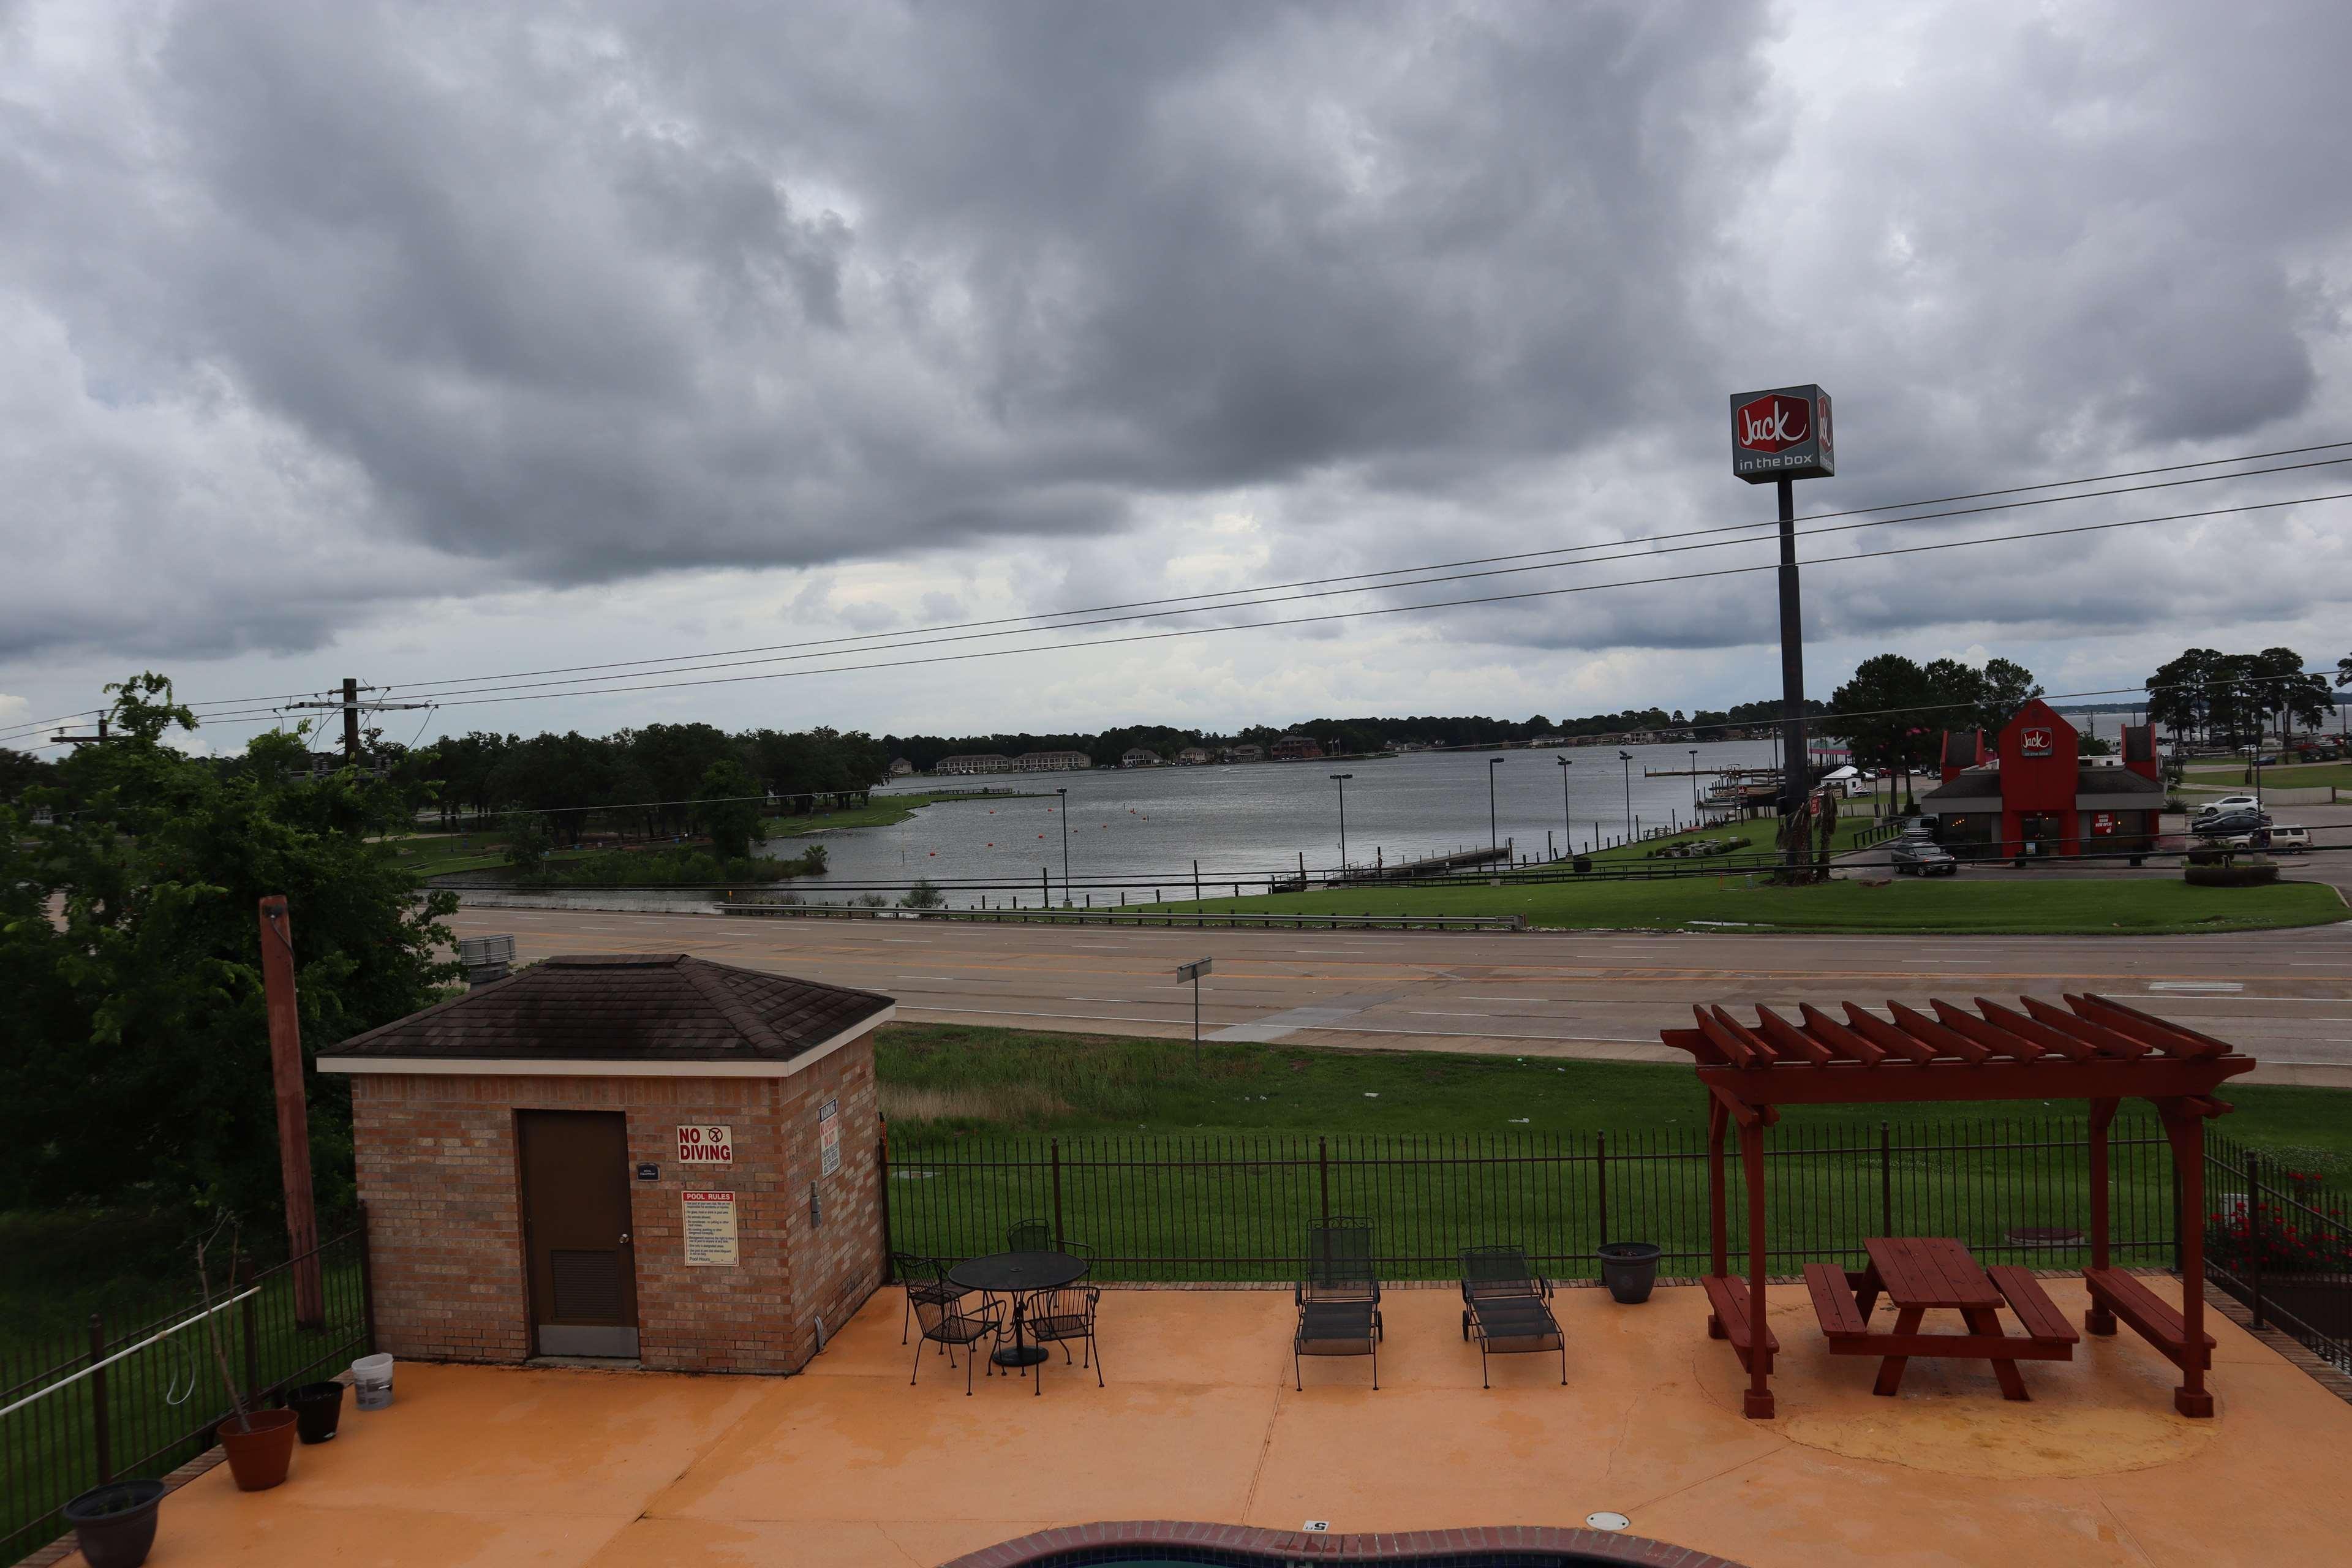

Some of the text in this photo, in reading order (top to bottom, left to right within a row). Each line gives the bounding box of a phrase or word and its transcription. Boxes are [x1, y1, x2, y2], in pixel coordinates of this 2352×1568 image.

[1741, 401, 1807, 445] Jack
[1740, 459, 1753, 470] in
[1756, 457, 1781, 468] the
[1784, 454, 1812, 466] box
[2022, 731, 2050, 748] Jack
[679, 1128, 701, 1144] NO
[680, 1145, 731, 1161] DIVING
